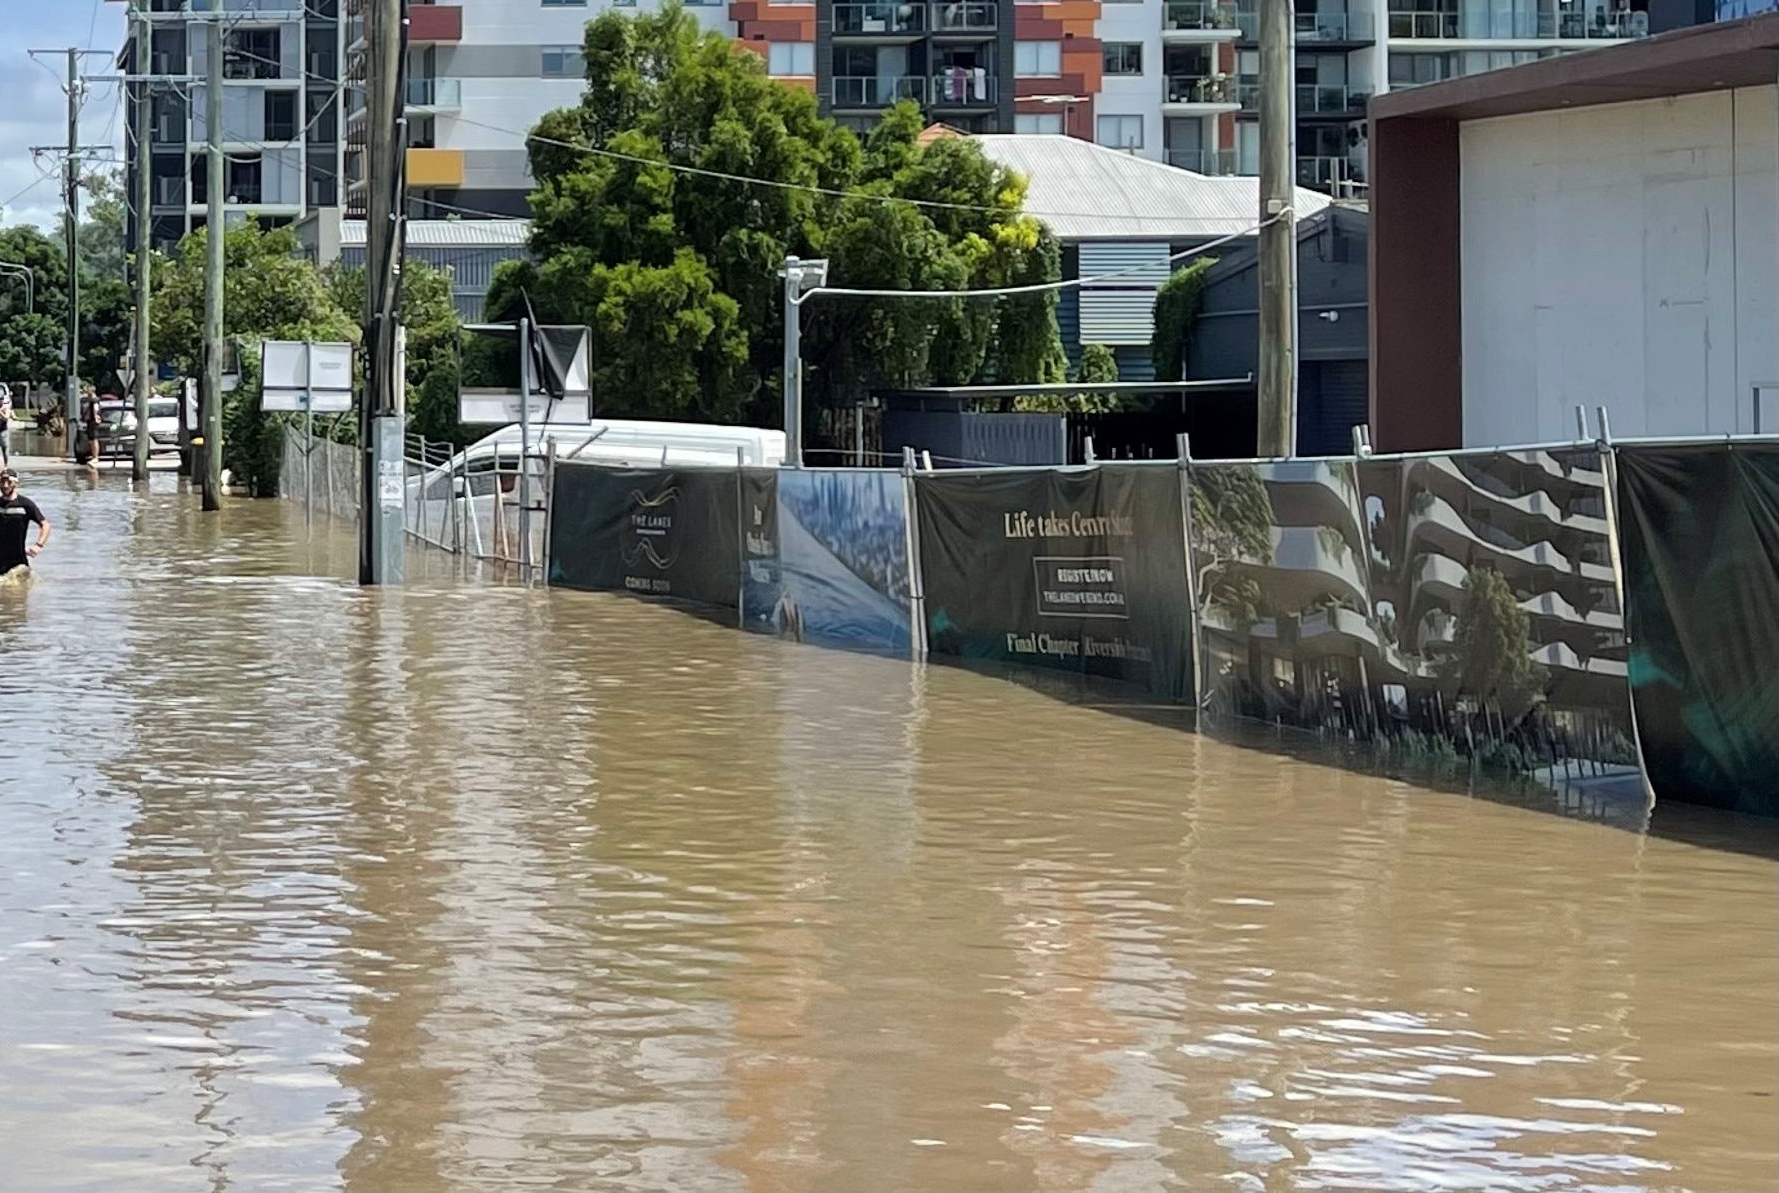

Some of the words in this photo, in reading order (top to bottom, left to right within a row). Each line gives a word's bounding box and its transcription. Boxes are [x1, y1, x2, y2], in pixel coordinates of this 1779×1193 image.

[1004, 510, 1035, 538] Life
[1037, 510, 1071, 537] takes
[1006, 632, 1037, 653] Final
[1038, 633, 1079, 660] Chapter
